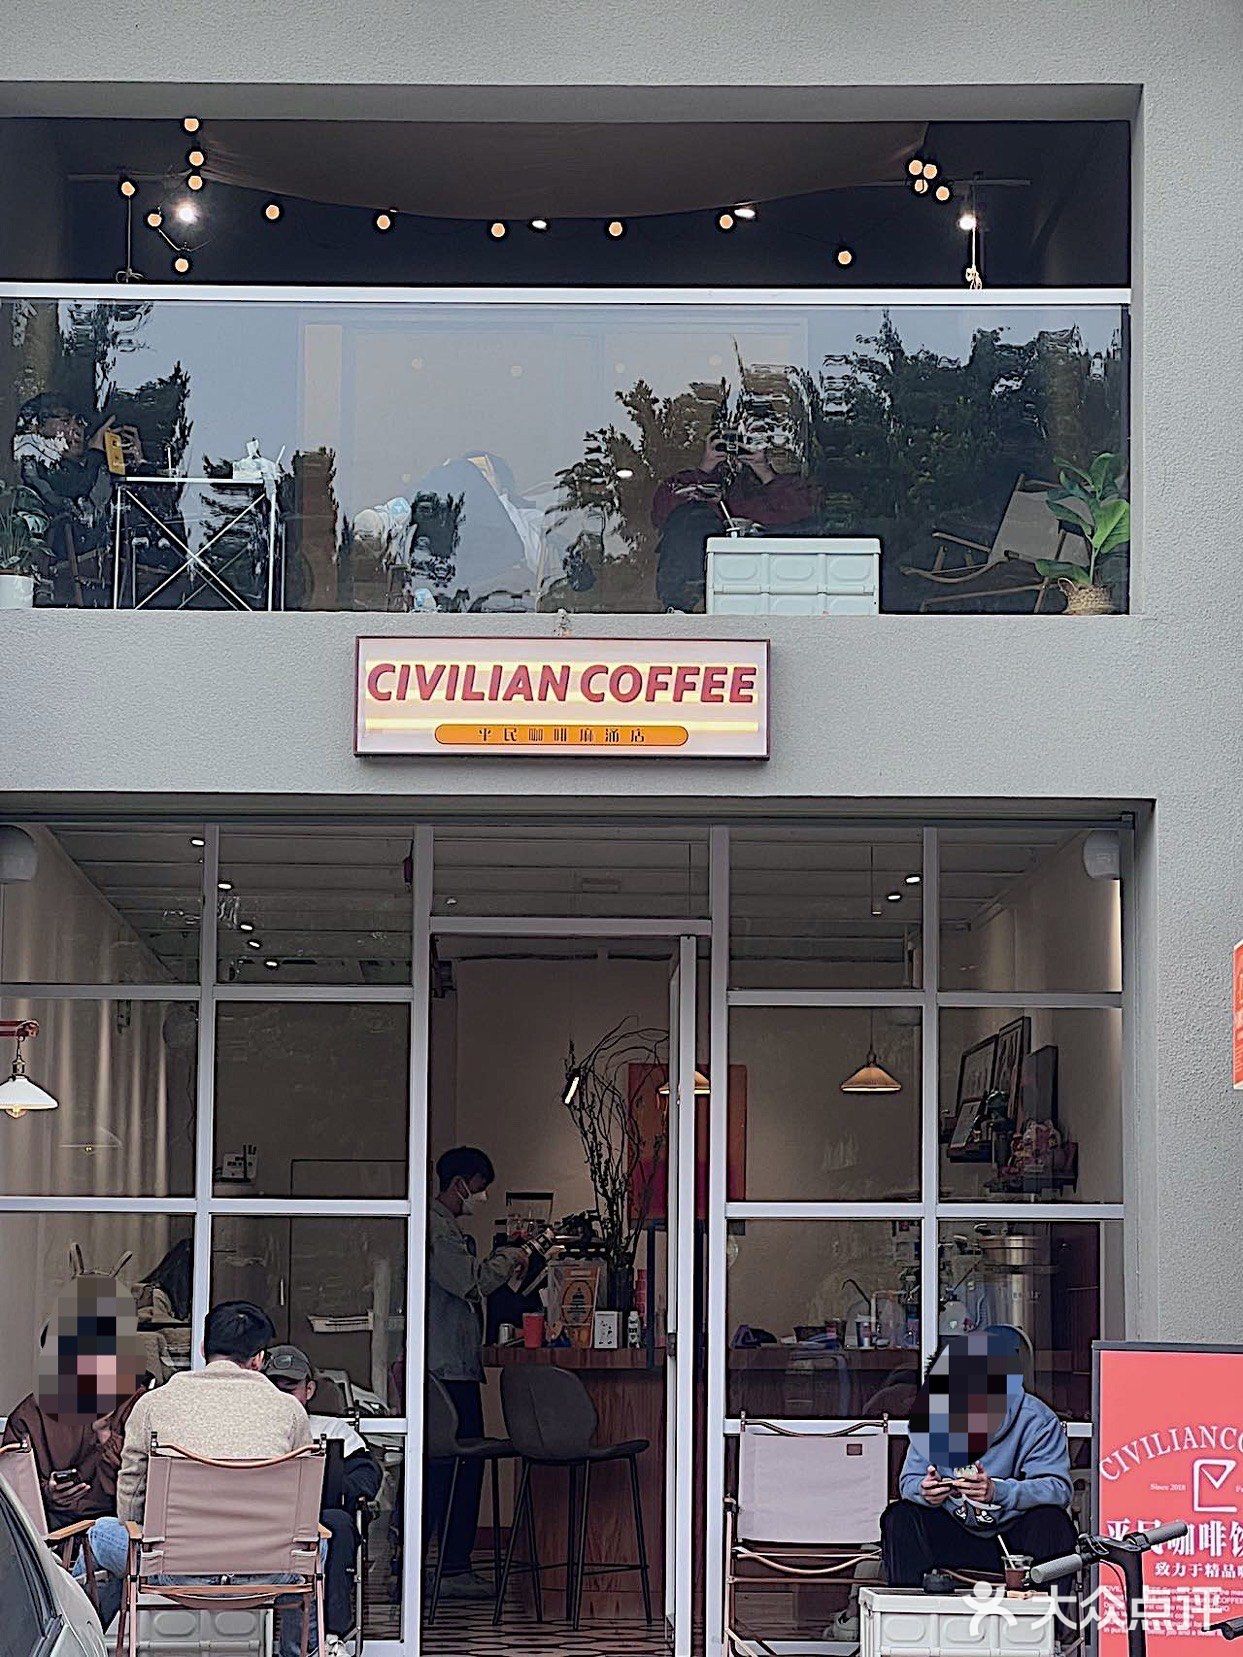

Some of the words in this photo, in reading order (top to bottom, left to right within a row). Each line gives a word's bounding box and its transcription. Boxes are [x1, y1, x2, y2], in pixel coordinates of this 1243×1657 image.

[367, 663, 571, 702] CIVILIAN
[580, 665, 758, 704] COFFEE
[1099, 1425, 1243, 1481] CIVILIANC
[1155, 1561, 1243, 1578] 致力于精品
